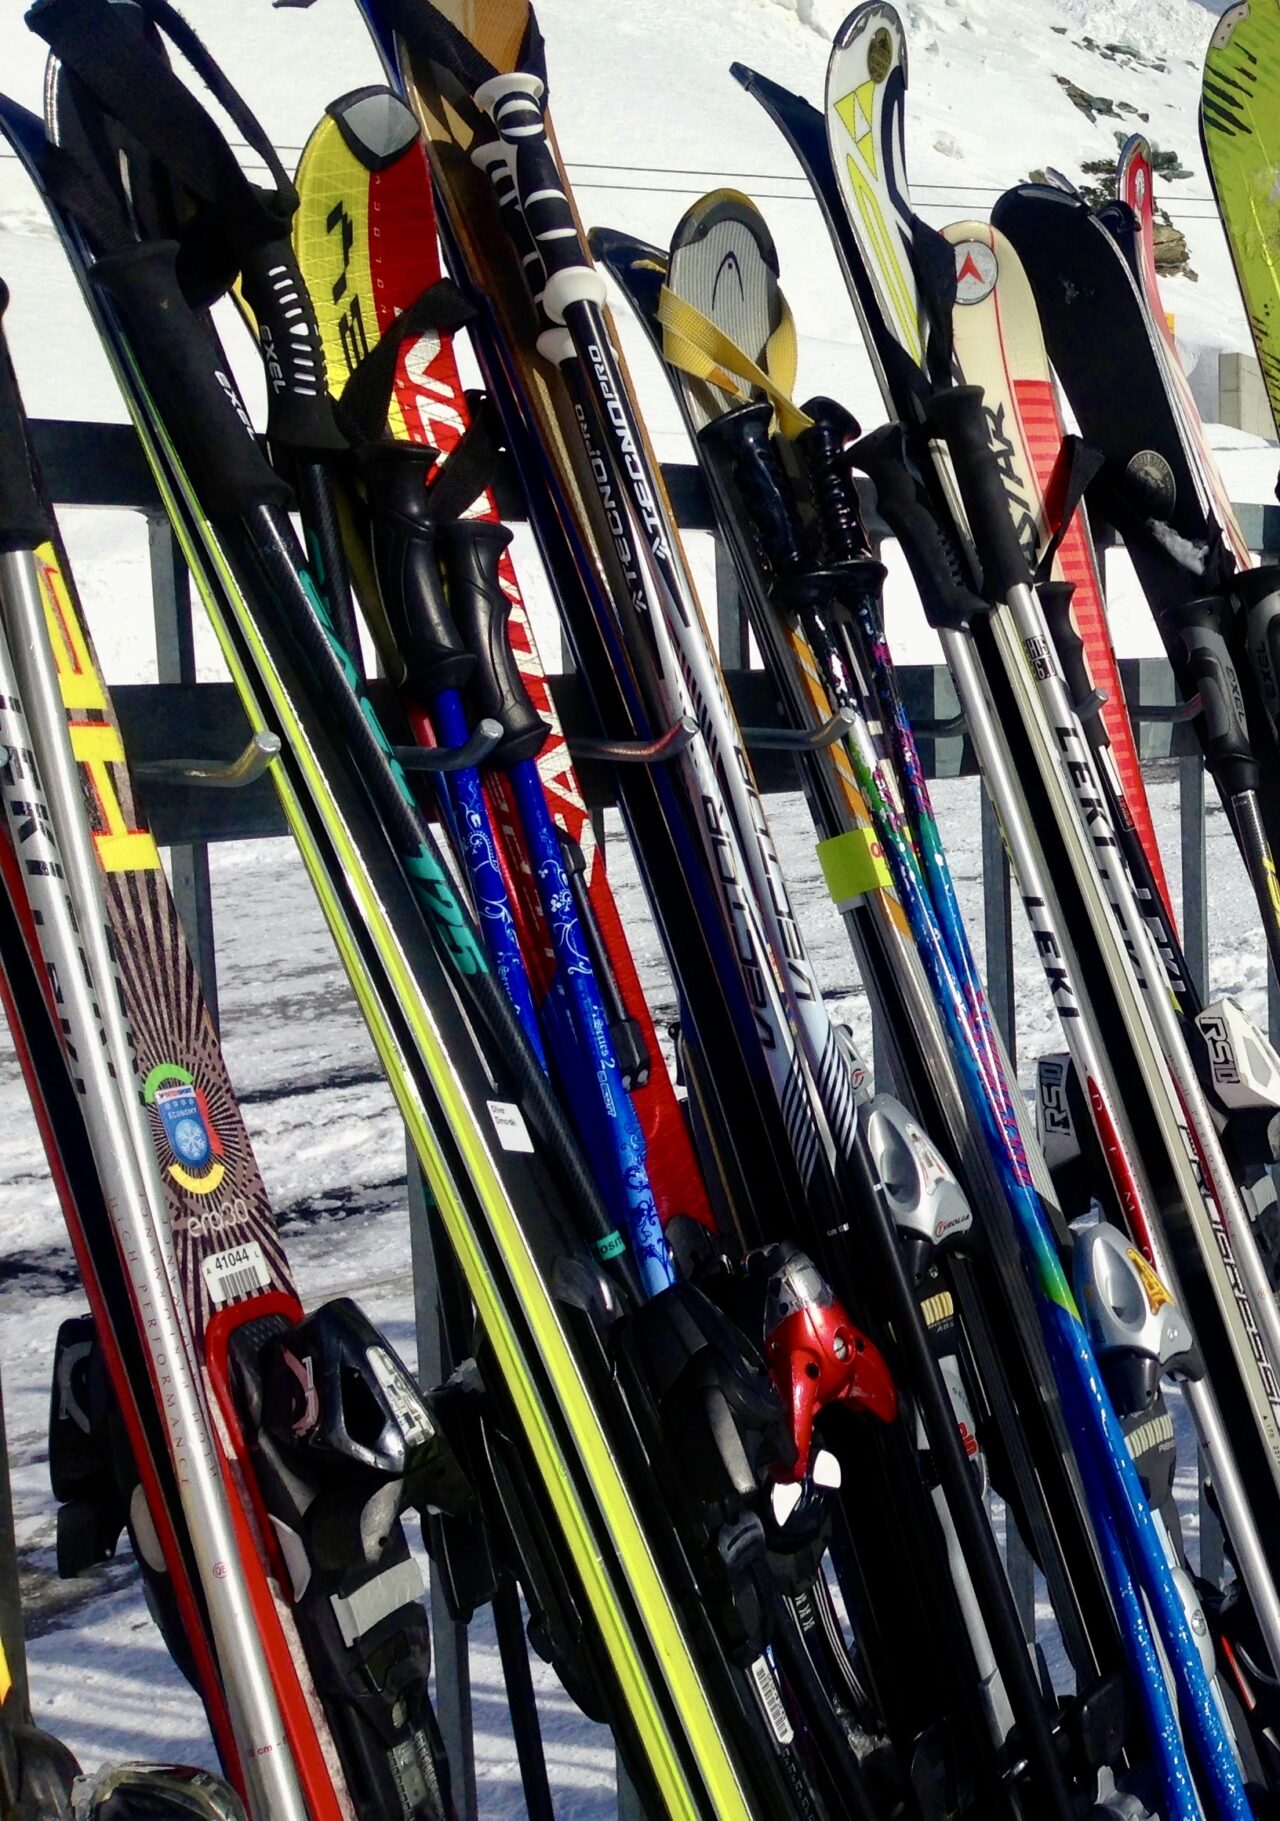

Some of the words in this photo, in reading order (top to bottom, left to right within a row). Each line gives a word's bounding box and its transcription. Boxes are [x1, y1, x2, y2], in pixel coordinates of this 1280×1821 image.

[260, 324, 287, 395] EXEL
[215, 370, 257, 441] EXEL
[587, 343, 664, 542] TECNOPRO
[574, 404, 637, 588] TECNOPRO
[1225, 666, 1244, 722] EXEL
[1055, 727, 1117, 849] LEKI
[400, 843, 490, 976] 125
[733, 746, 817, 1003] VECTOR
[701, 794, 777, 1050] VECTOR
[1021, 896, 1083, 1021] LEKI
[593, 1017, 611, 1056] Series
[600, 1056, 616, 1071] 2
[1202, 1014, 1241, 1086] RS10
[167, 1106, 199, 1119] ECONOMY
[599, 1081, 617, 1118] SCOTT
[1047, 1061, 1071, 1137] RS10
[931, 1208, 973, 1238] TYROLIA
[213, 1248, 251, 1273] 41044
[138, 1282, 190, 1488] PERFORMANCE
